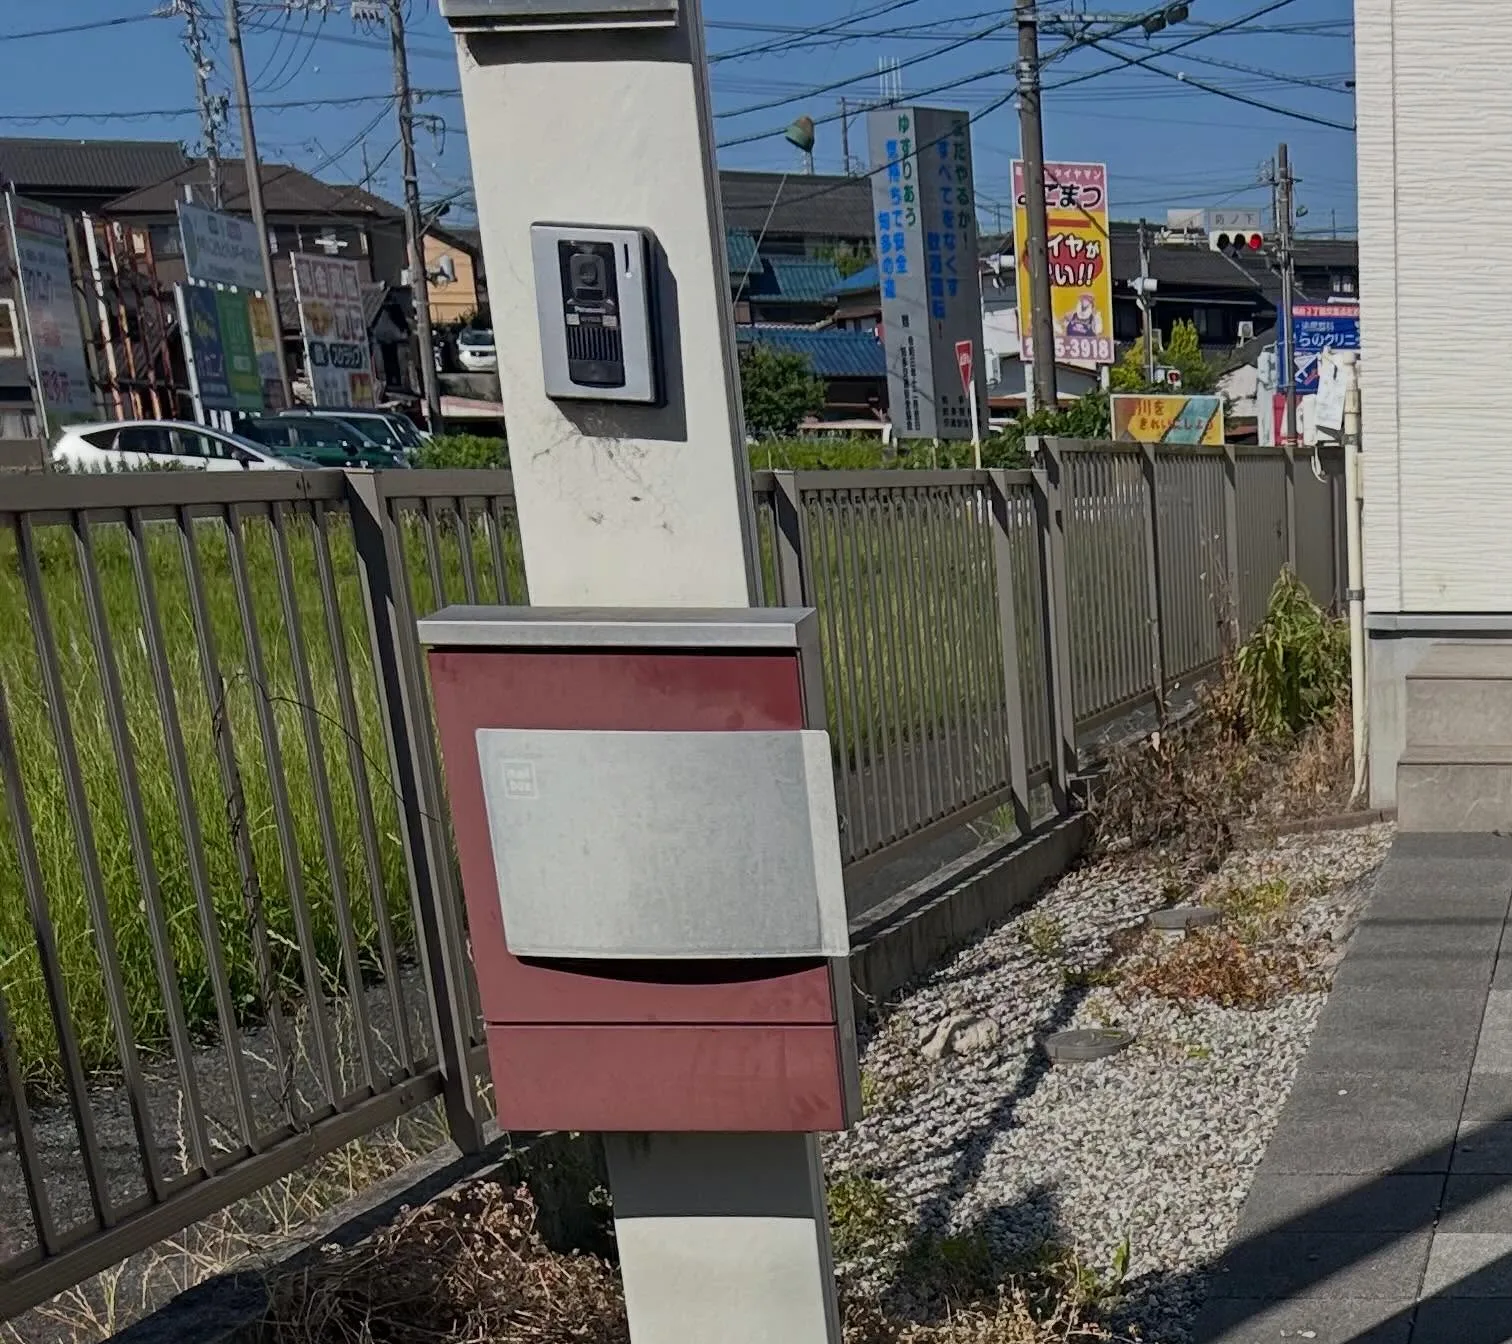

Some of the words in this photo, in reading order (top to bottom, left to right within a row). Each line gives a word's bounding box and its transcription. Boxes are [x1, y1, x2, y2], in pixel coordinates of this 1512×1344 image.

[1045, 232, 1101, 260] イヤが
[1047, 262, 1096, 288] い!!
